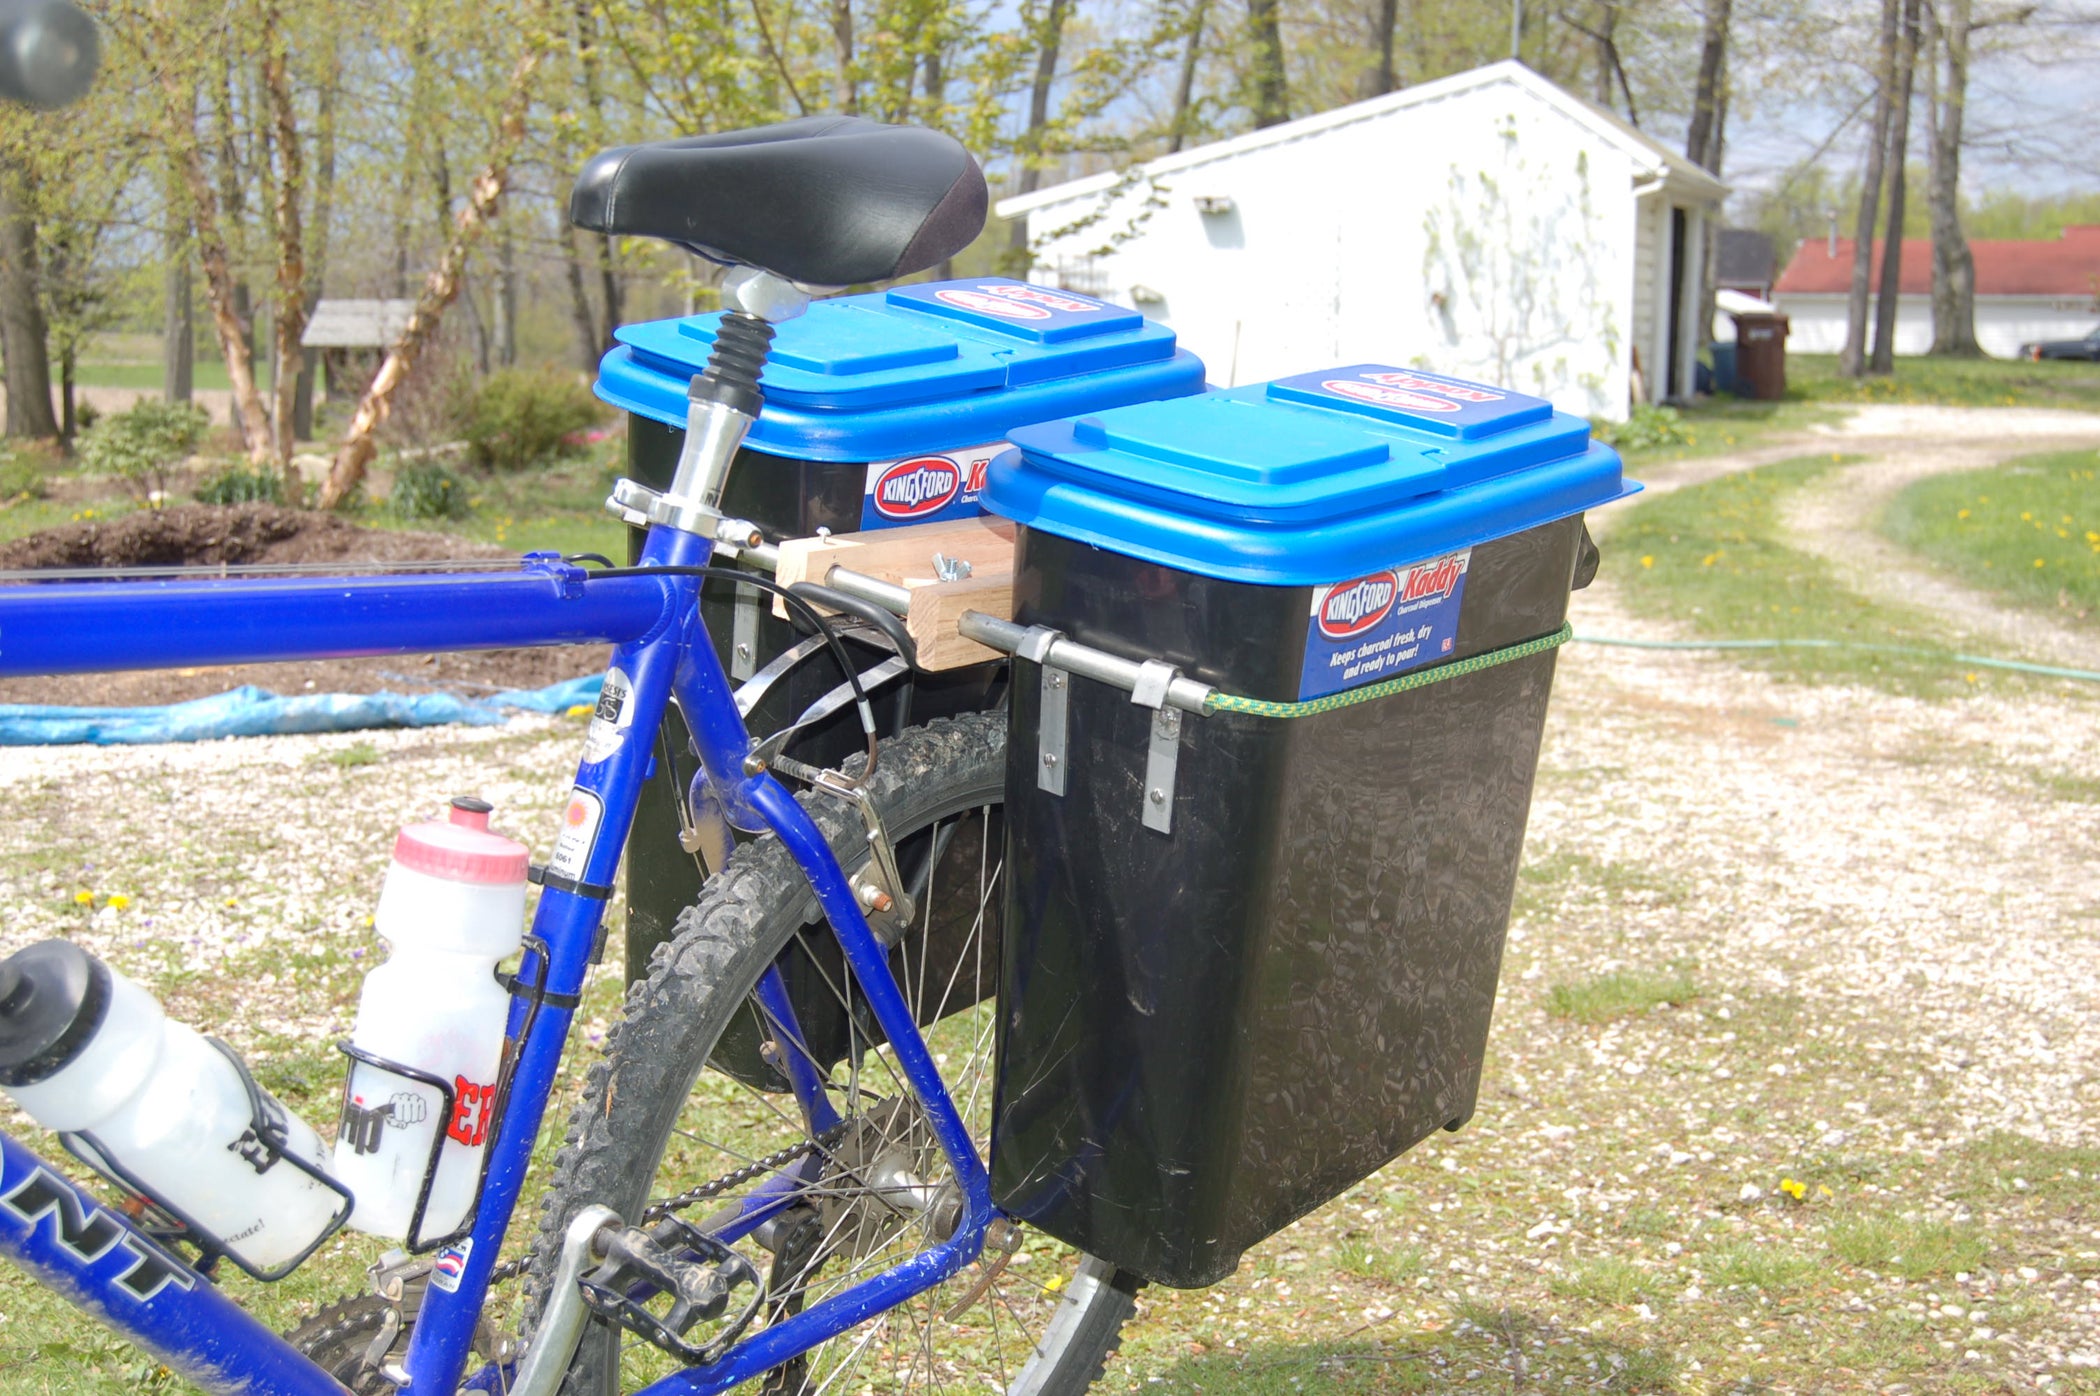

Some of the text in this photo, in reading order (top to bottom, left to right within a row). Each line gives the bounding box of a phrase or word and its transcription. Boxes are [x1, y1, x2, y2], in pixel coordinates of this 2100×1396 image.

[882, 466, 954, 507] KINGSFORD
[1326, 553, 1465, 625] KINGSFORD Kaddy
[1329, 624, 1433, 667] Keeps charcoal fresh, dry
[1343, 660, 1361, 680] and
[1360, 654, 1386, 675] ready
[1386, 652, 1396, 667] to
[1395, 643, 1420, 667] pour!
[0, 1158, 197, 1303] NT
